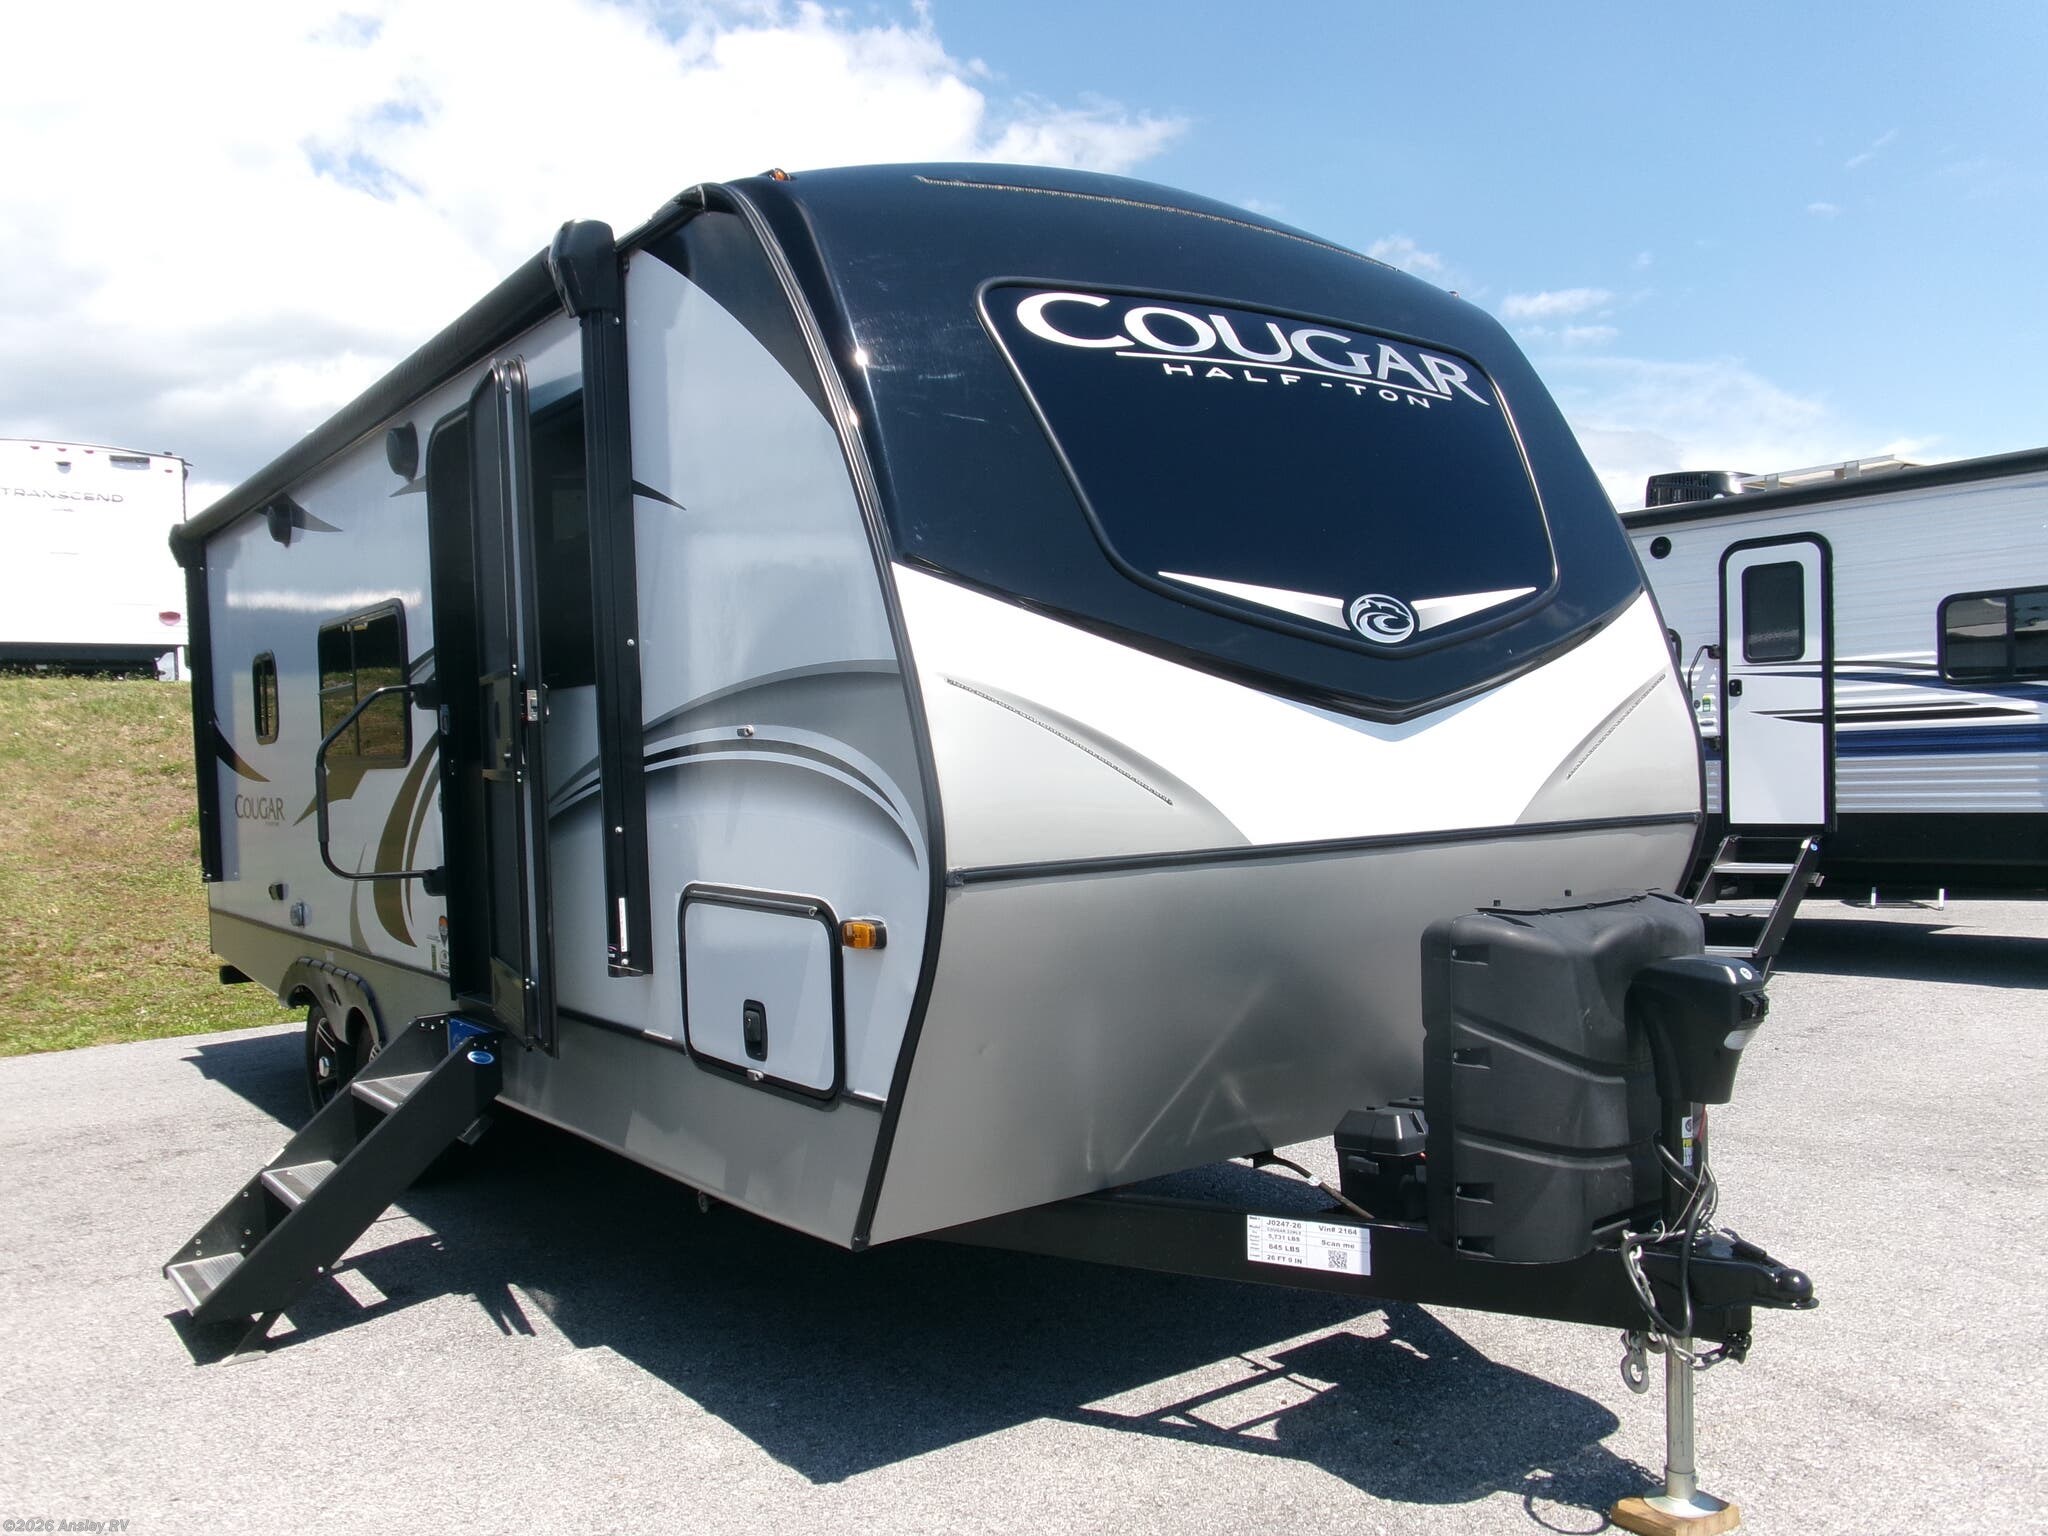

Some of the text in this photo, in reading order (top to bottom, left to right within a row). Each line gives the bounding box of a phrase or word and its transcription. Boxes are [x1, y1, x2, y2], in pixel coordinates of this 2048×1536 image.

[1016, 292, 1490, 406] COUGAR
[1163, 363, 1431, 409] HALF-TON
[1, 487, 124, 503] TRANSCEND
[235, 794, 285, 820] COUGAR
[1321, 1239, 1341, 1247] Scan
